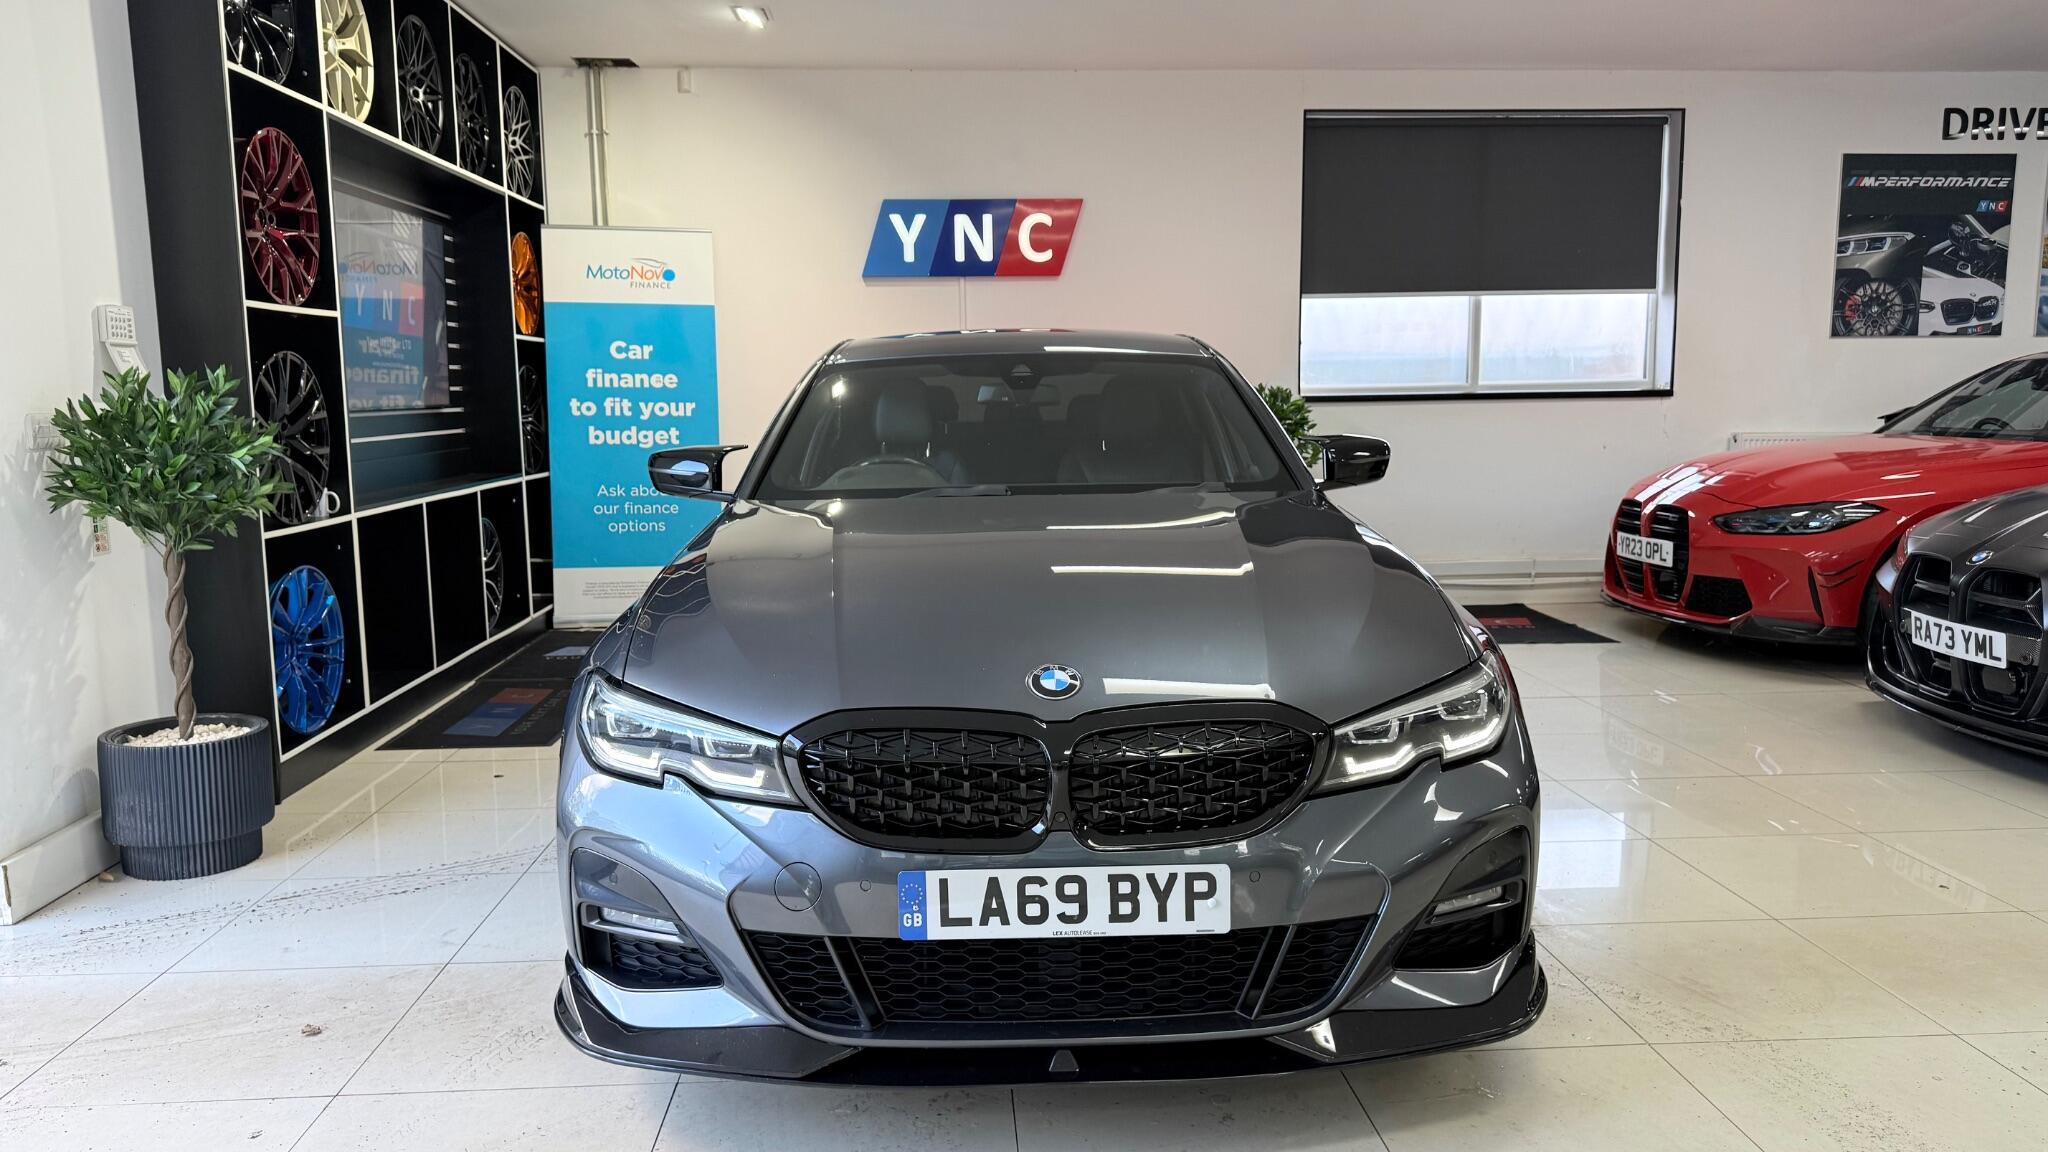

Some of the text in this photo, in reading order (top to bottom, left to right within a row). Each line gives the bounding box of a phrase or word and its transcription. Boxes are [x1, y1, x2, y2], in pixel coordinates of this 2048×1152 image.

[1980, 201, 2005, 210] YNC
[889, 213, 1053, 263] YNC
[609, 340, 654, 359] Car
[585, 368, 679, 388] finance
[569, 397, 696, 420] to fit your
[588, 425, 680, 448] budget
[597, 484, 668, 497] Ask abo
[593, 501, 679, 515] our finance
[608, 519, 666, 534] options
[1620, 535, 1667, 562] YR23 OPL
[1914, 616, 2002, 662] RA73 YML
[938, 871, 1218, 928] LA69 BYP
[903, 913, 923, 928] GB
